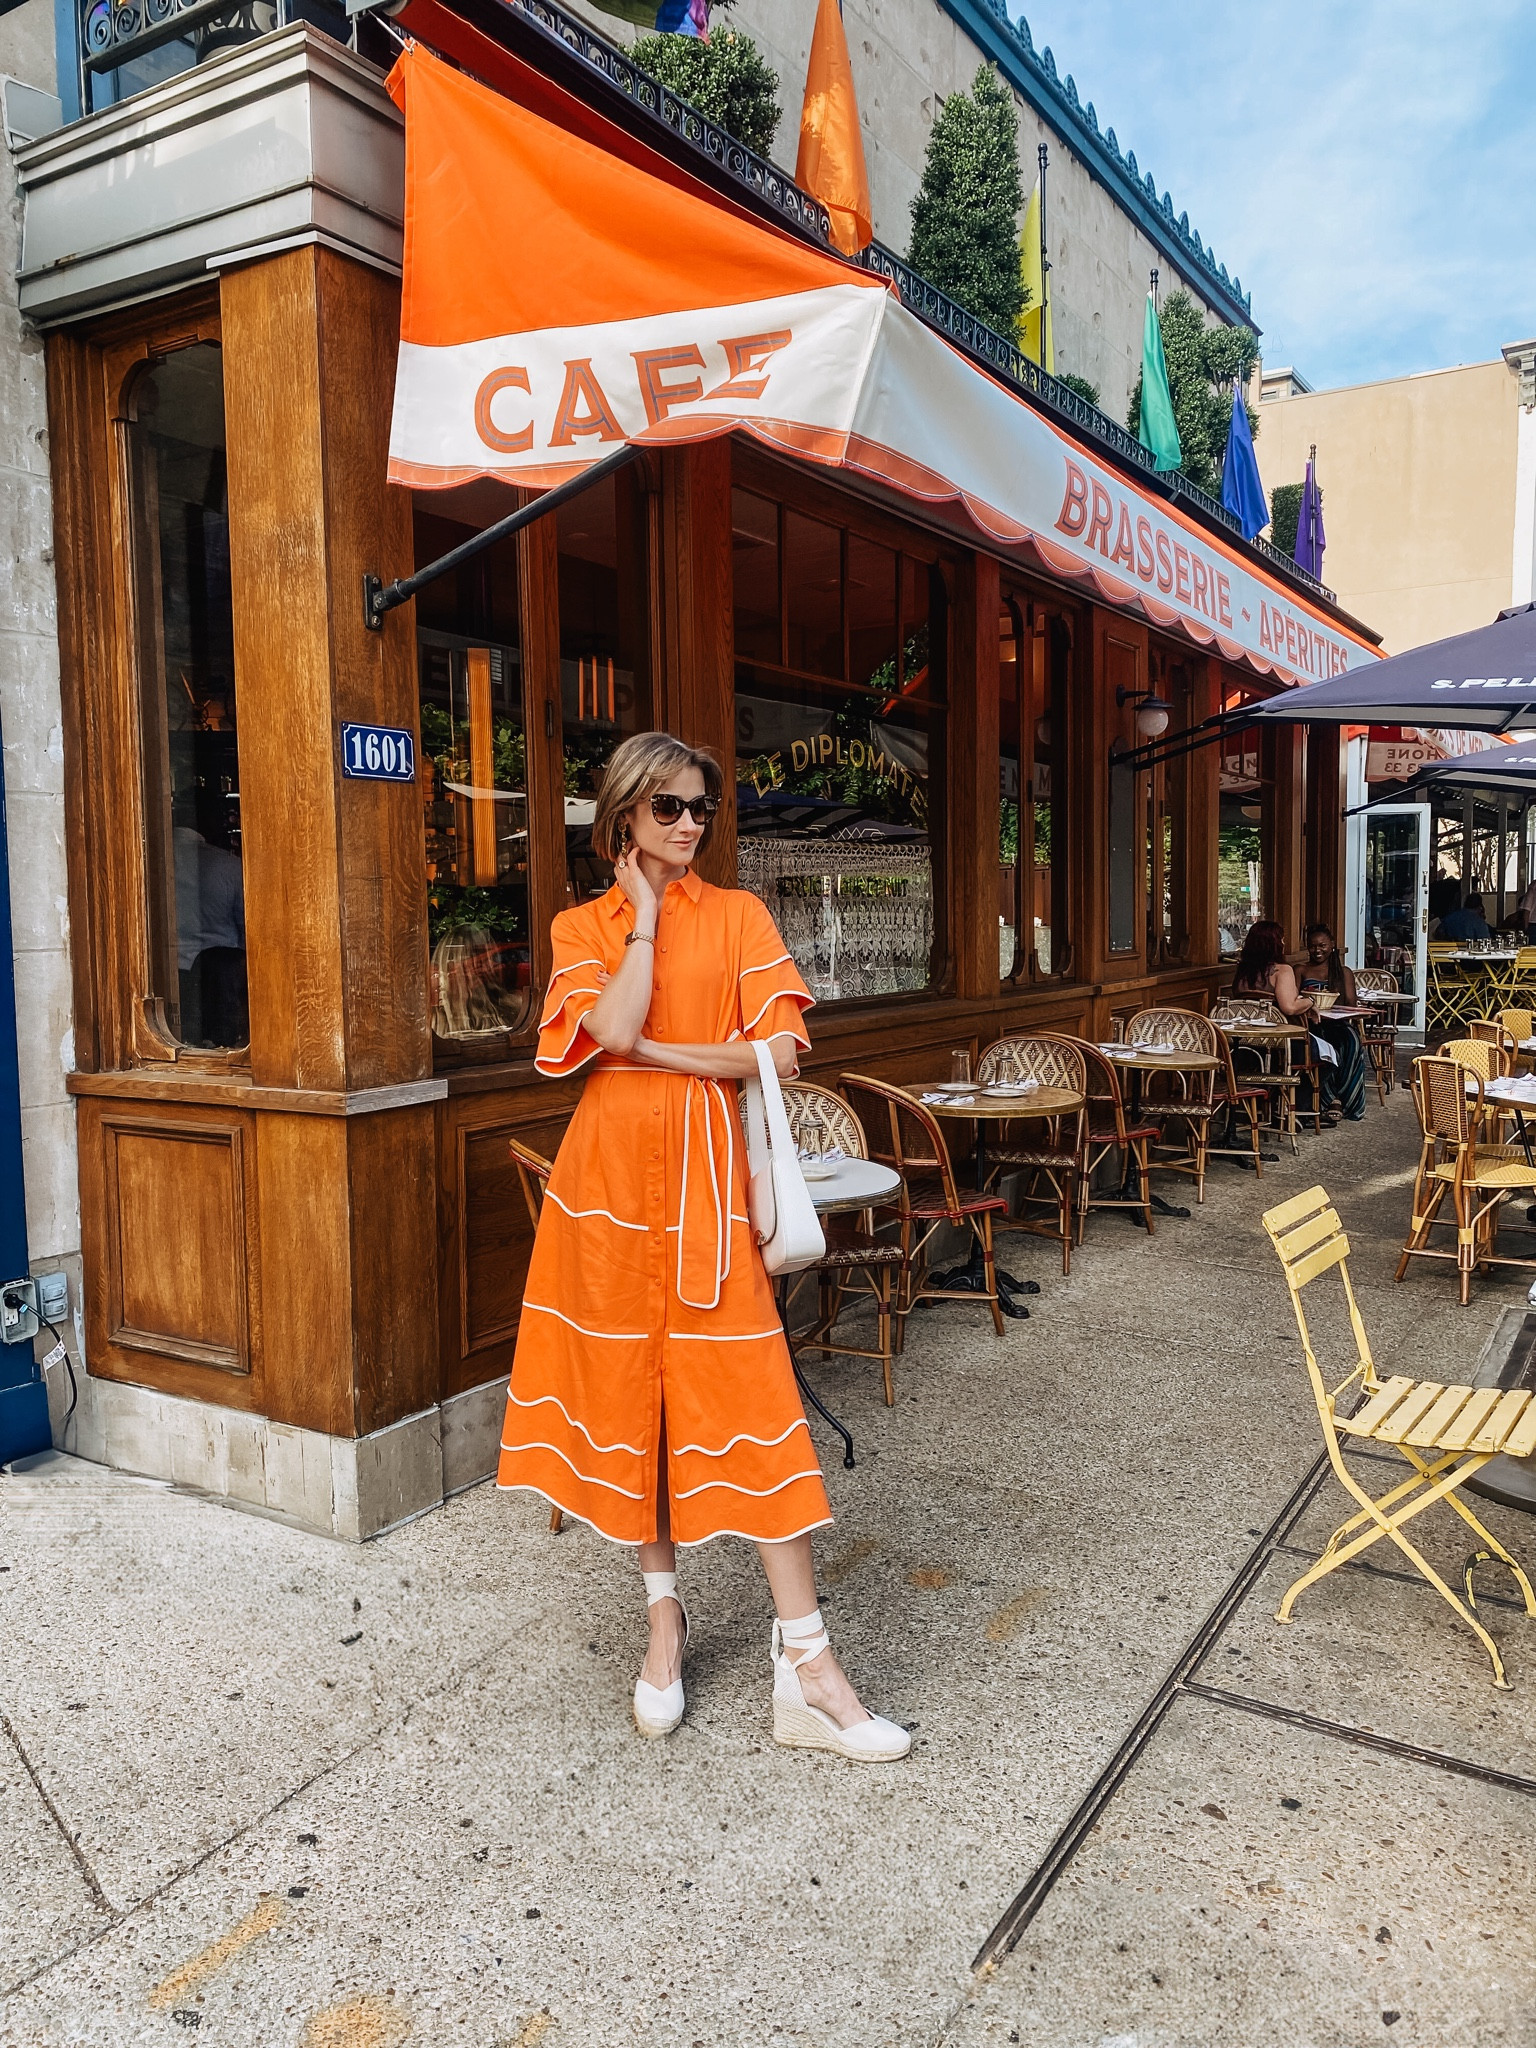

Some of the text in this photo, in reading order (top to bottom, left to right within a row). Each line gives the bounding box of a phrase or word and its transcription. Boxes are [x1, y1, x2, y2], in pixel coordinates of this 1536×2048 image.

[1054, 455, 1233, 630] BRASSERIE
[351, 731, 409, 774] 1601
[752, 733, 929, 818] LE DIPLOMATE
